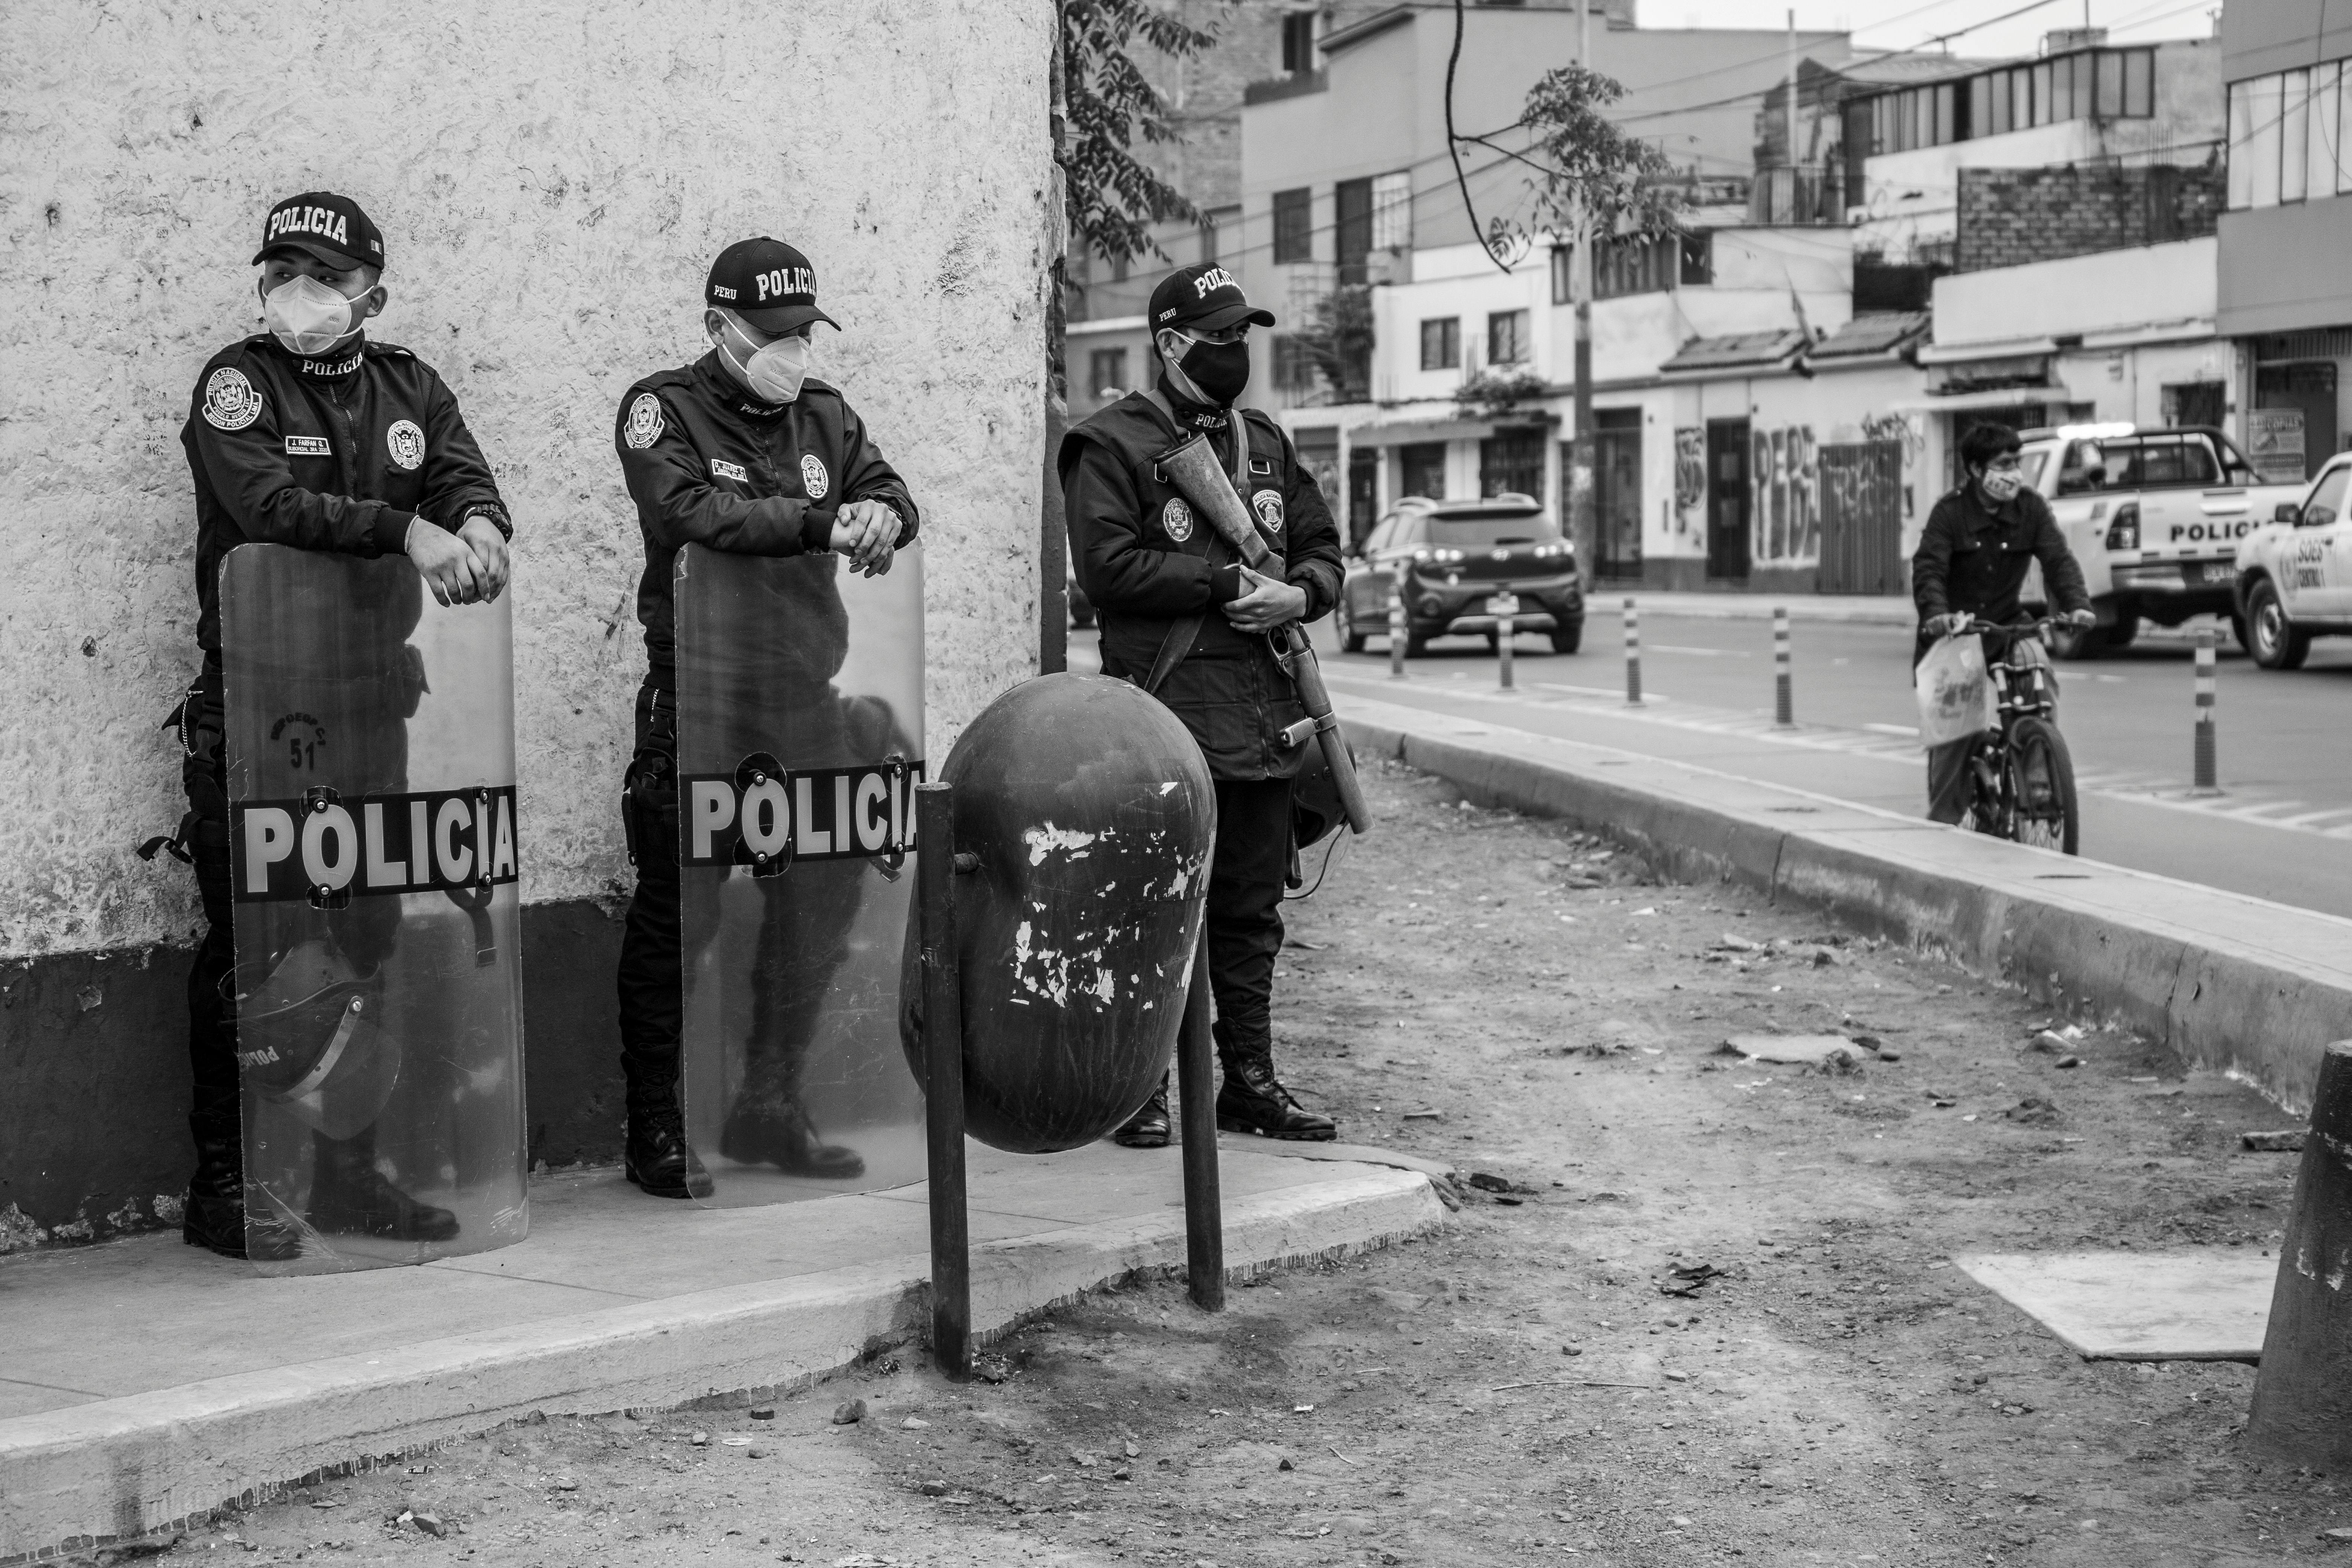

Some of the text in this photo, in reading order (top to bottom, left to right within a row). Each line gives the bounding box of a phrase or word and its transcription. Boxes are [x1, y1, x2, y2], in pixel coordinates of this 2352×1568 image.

[269, 206, 347, 245] POLICIA
[714, 285, 737, 300] PERU
[756, 267, 816, 301] POLICIA
[1159, 308, 1176, 322] PERU
[302, 352, 362, 375] POLICIA
[770, 368, 783, 377] KN95
[209, 374, 220, 395] POLICIA
[220, 370, 247, 387] NACIONAL
[207, 402, 259, 427] REGION POLICIAL LIMA
[213, 406, 229, 419] PUEBLO
[231, 409, 246, 419] HECHO
[722, 463, 738, 473] JUAREZ
[290, 738, 314, 771] 51
[245, 796, 515, 893] POLICIA
